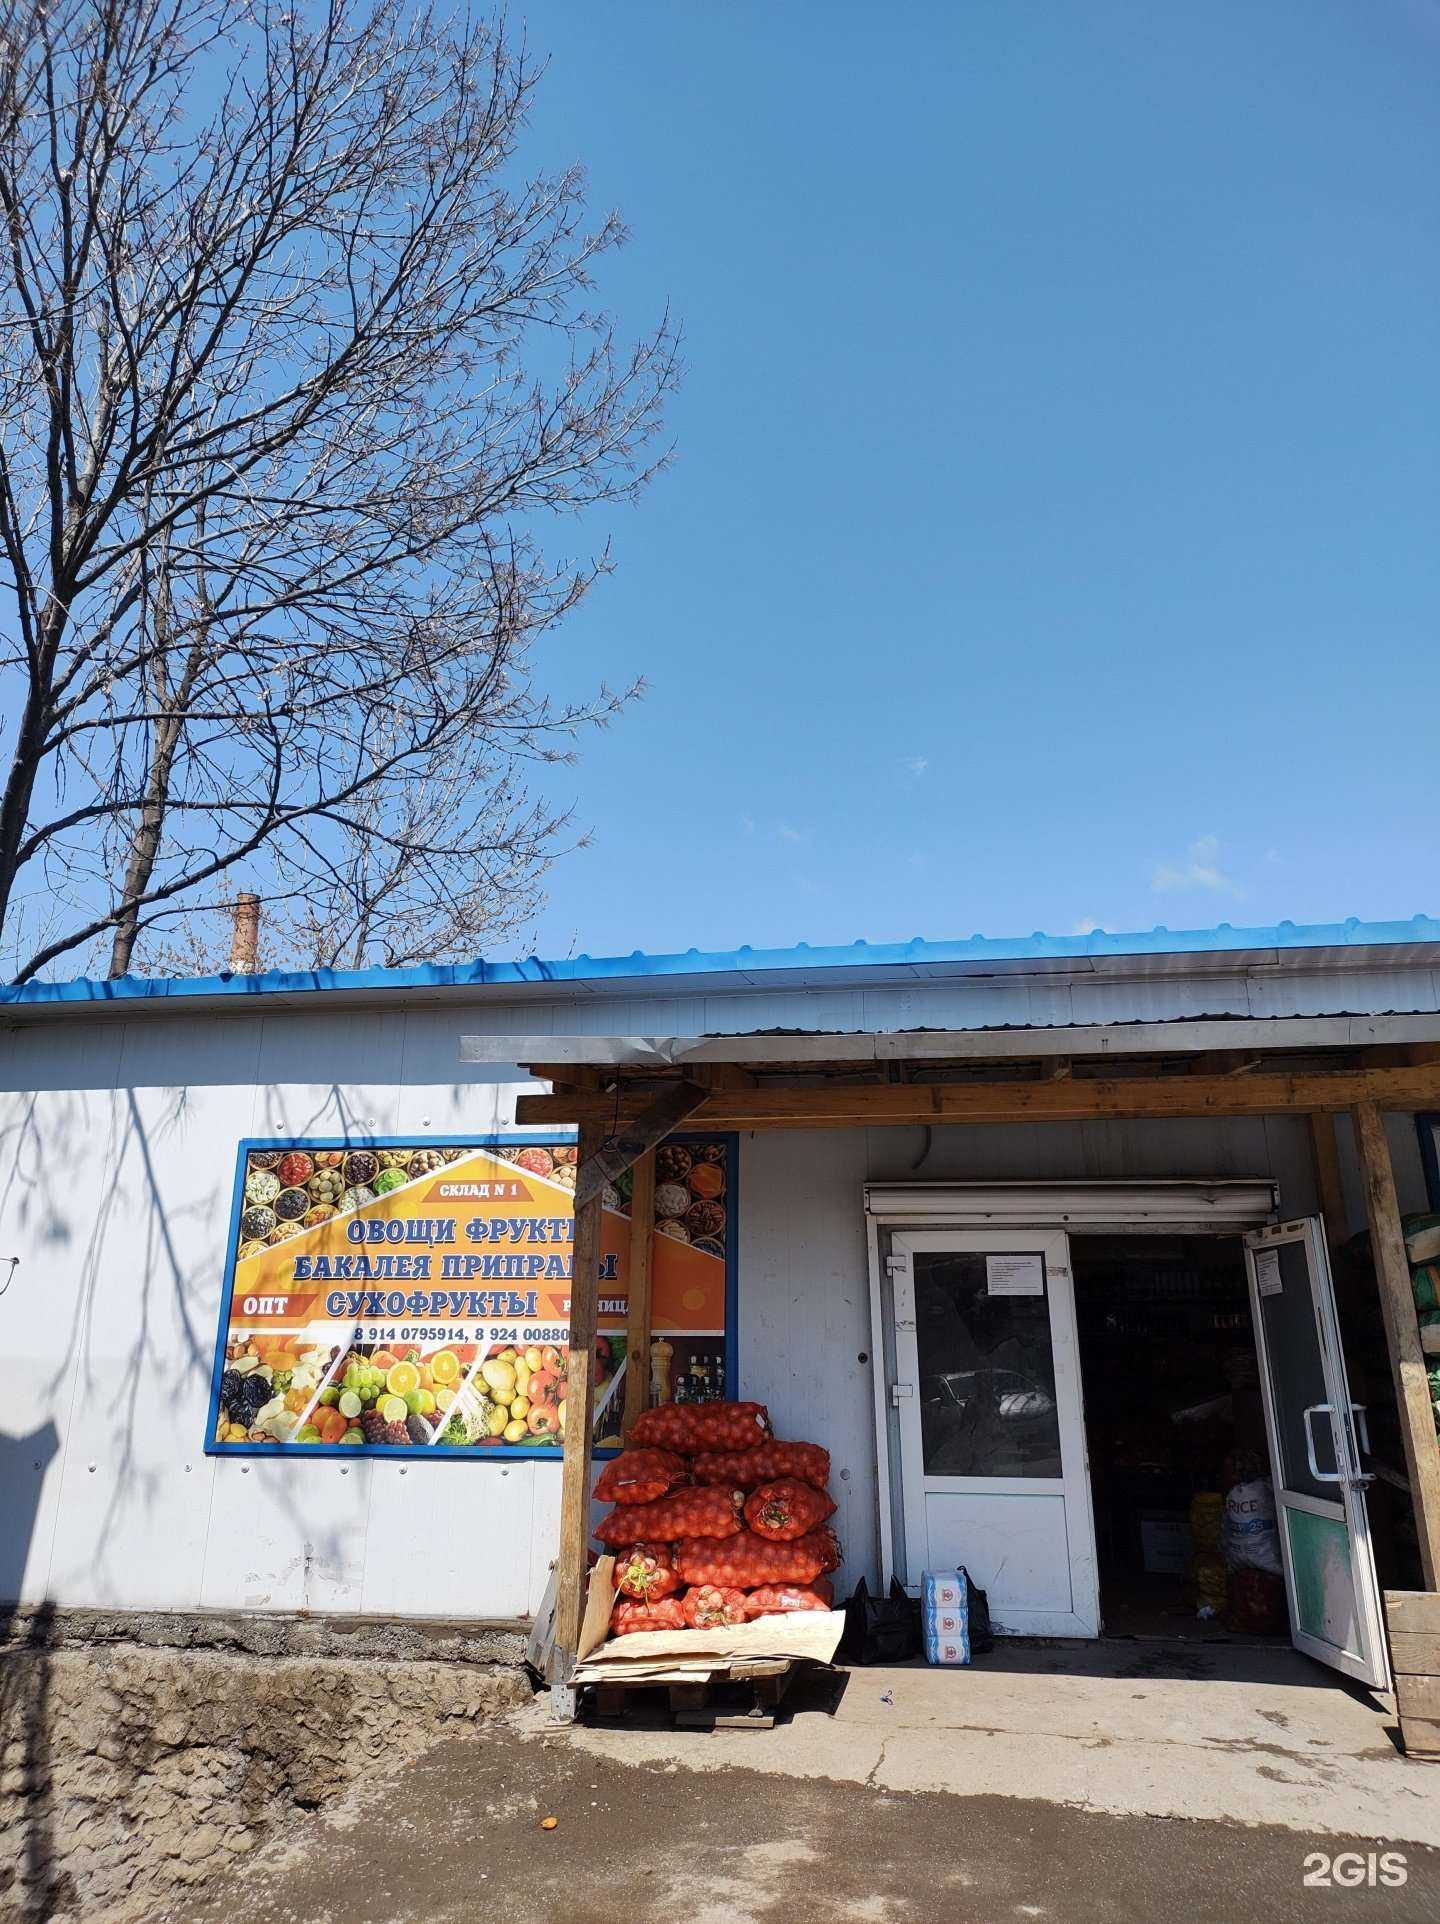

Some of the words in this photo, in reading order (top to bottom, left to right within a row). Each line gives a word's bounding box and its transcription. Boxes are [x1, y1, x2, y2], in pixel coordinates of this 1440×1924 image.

[439, 1183, 490, 1198] СКЛАД
[494, 1183, 505, 1196] N
[511, 1183, 519, 1196] 1
[347, 1218, 456, 1248] ОВОЩИ
[293, 1254, 432, 1280] БАКАЛЕЯ
[243, 1297, 289, 1315] ОПТ
[326, 1290, 538, 1318] СУХОФРУКТЫ
[354, 1327, 364, 1340] 8
[368, 1327, 396, 1340] 914
[400, 1327, 469, 1343] 0795914,
[475, 1327, 484, 1340] 8
[489, 1327, 518, 1341] 924
